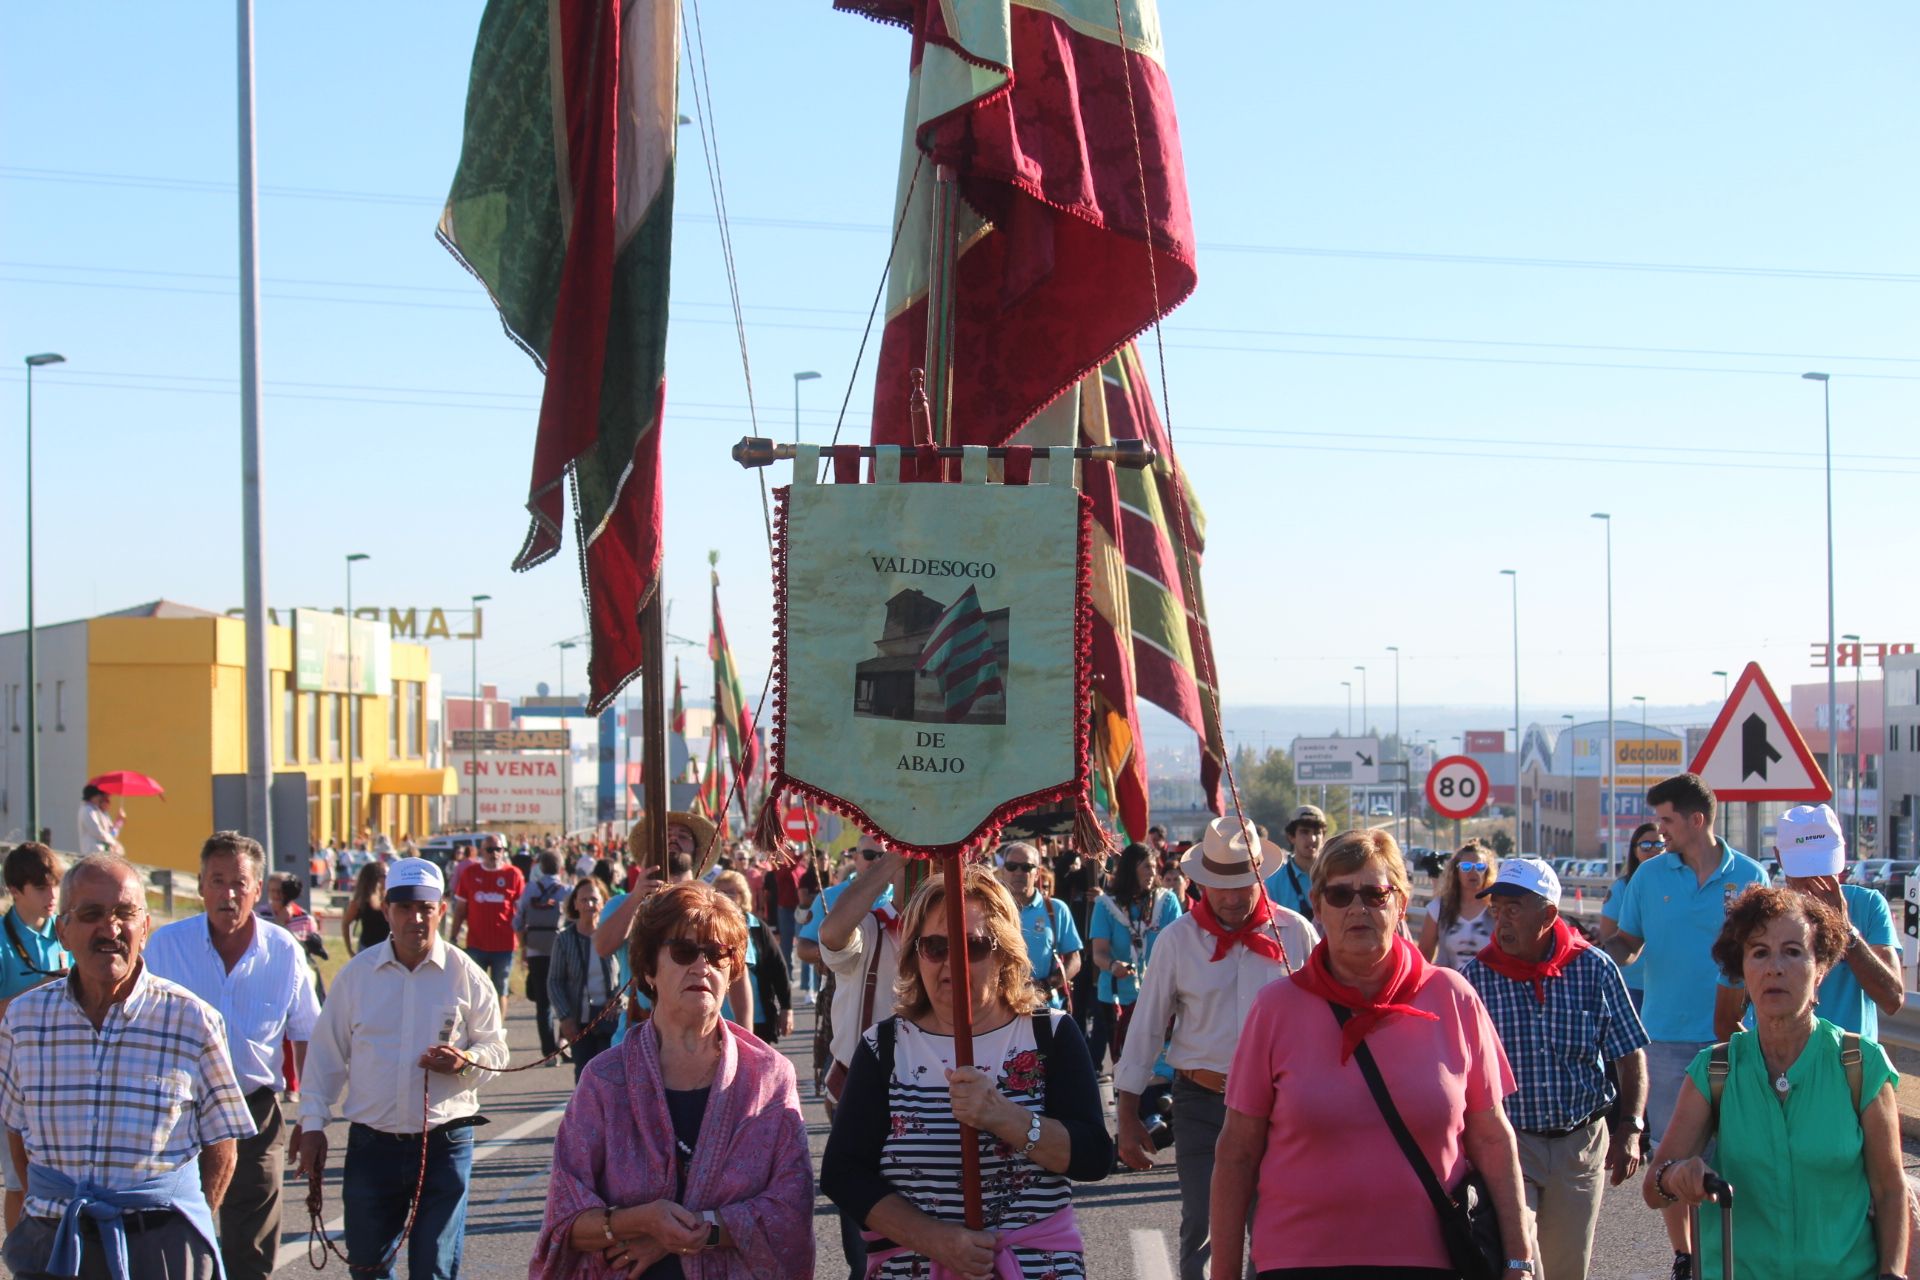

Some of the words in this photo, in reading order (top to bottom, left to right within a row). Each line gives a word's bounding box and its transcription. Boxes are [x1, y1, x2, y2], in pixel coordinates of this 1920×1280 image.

[872, 557, 996, 579] VALDESOGO
[917, 731, 945, 748] DE
[1619, 743, 1678, 760] decolux
[463, 762, 488, 775] EN
[496, 762, 557, 776] VENTA
[896, 754, 964, 774] ABAJO
[1439, 777, 1475, 797] 80
[1909, 888, 1917, 898] 6
